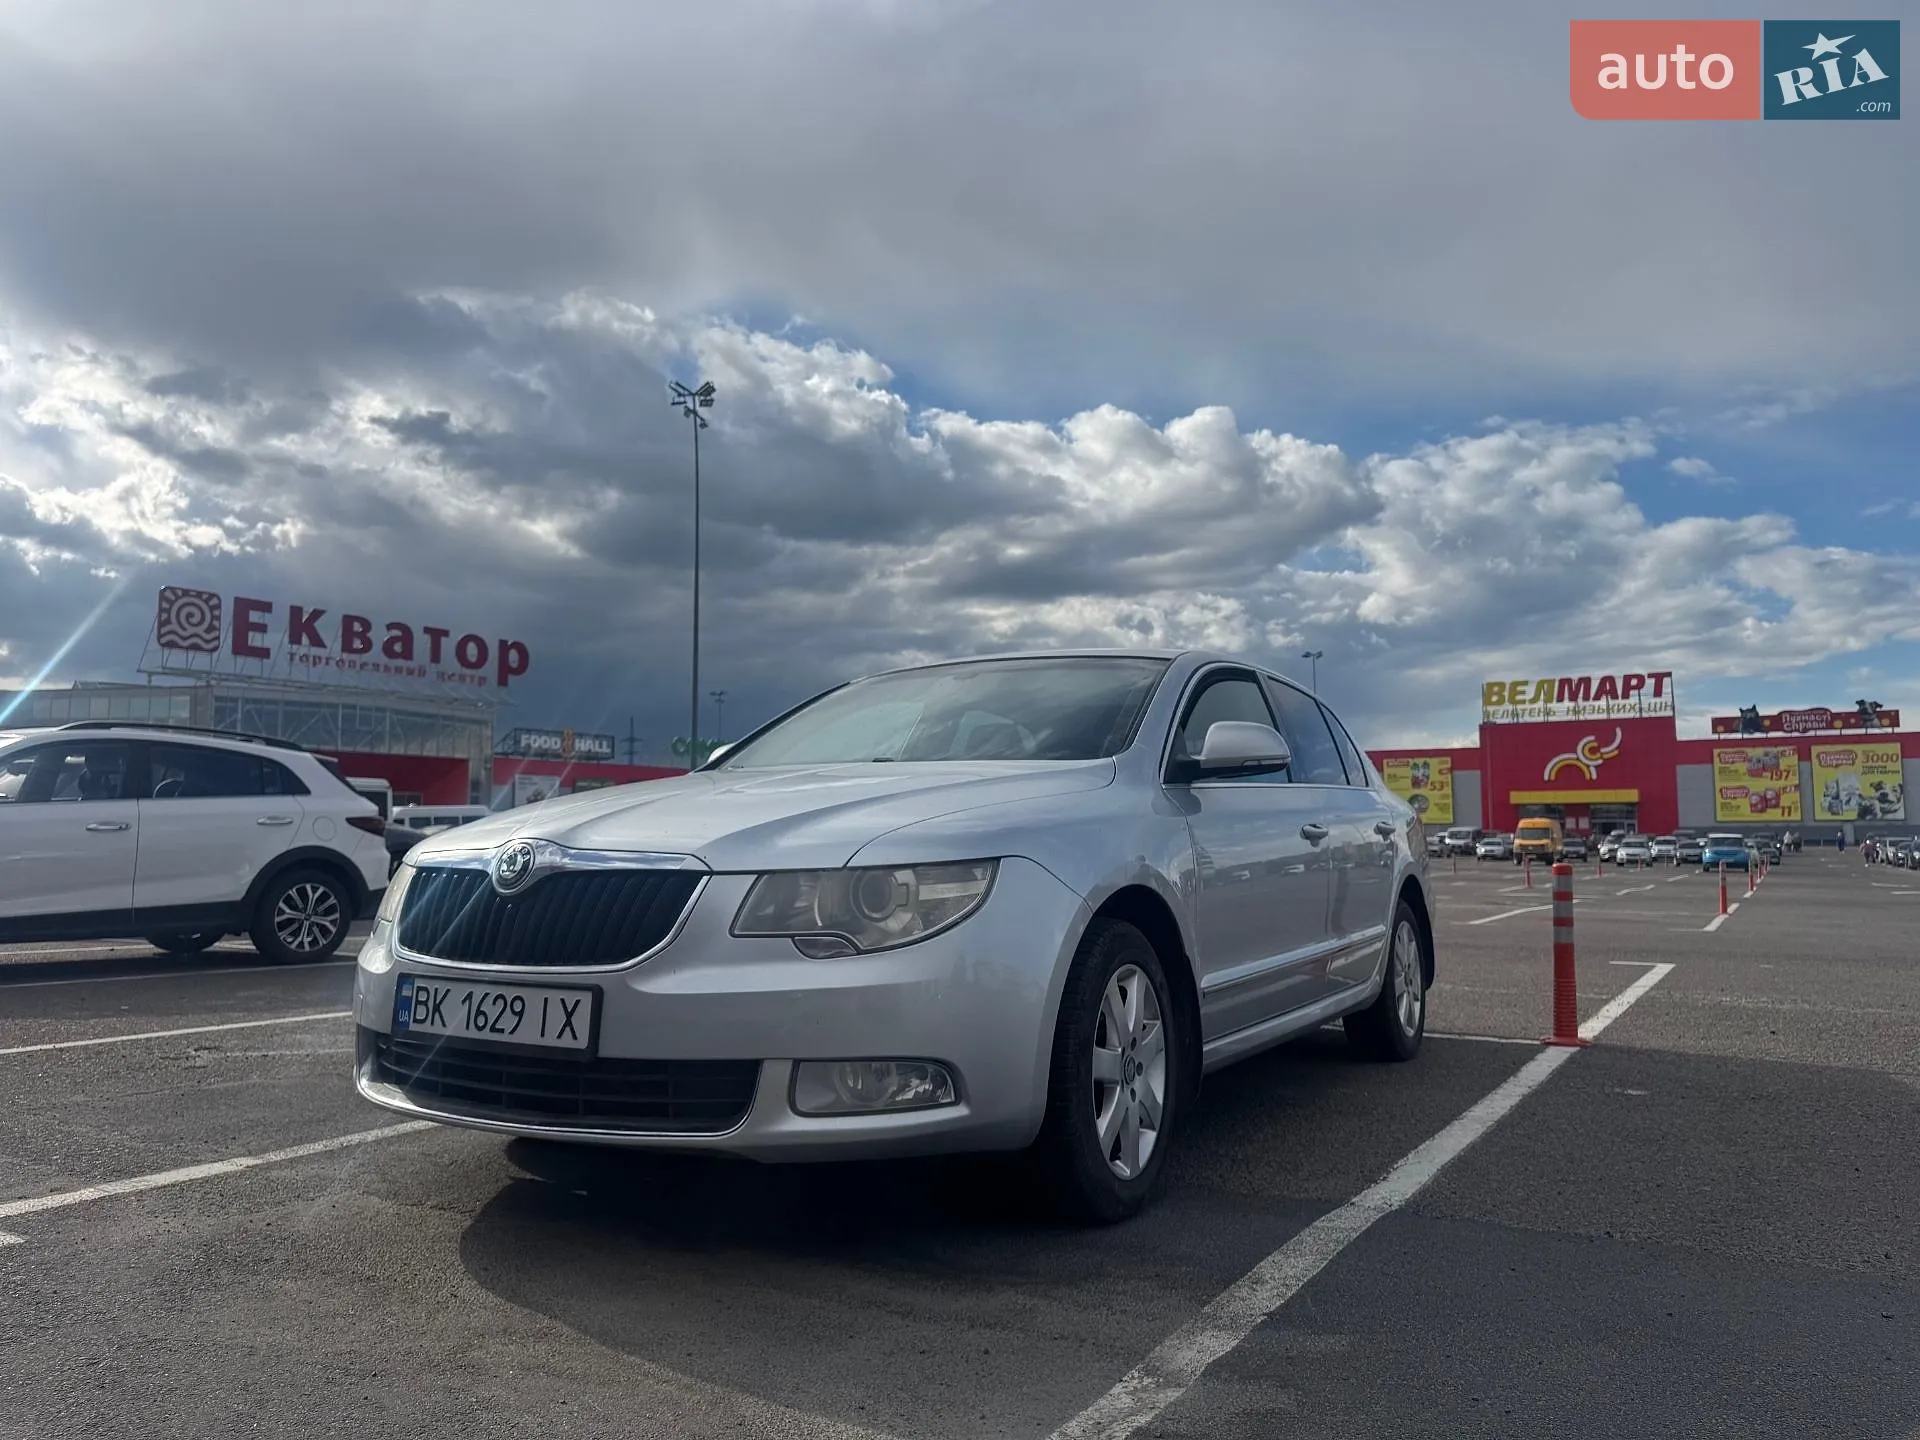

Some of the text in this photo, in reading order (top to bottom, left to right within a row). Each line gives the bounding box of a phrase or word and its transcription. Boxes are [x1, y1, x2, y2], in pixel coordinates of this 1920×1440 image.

[1485, 671, 1673, 706] ВЕЛМАРТ
[520, 734, 610, 752] FOOD HALL
[398, 1009, 409, 1023] UA
[412, 985, 451, 1028] BK
[461, 990, 526, 1035] 1629
